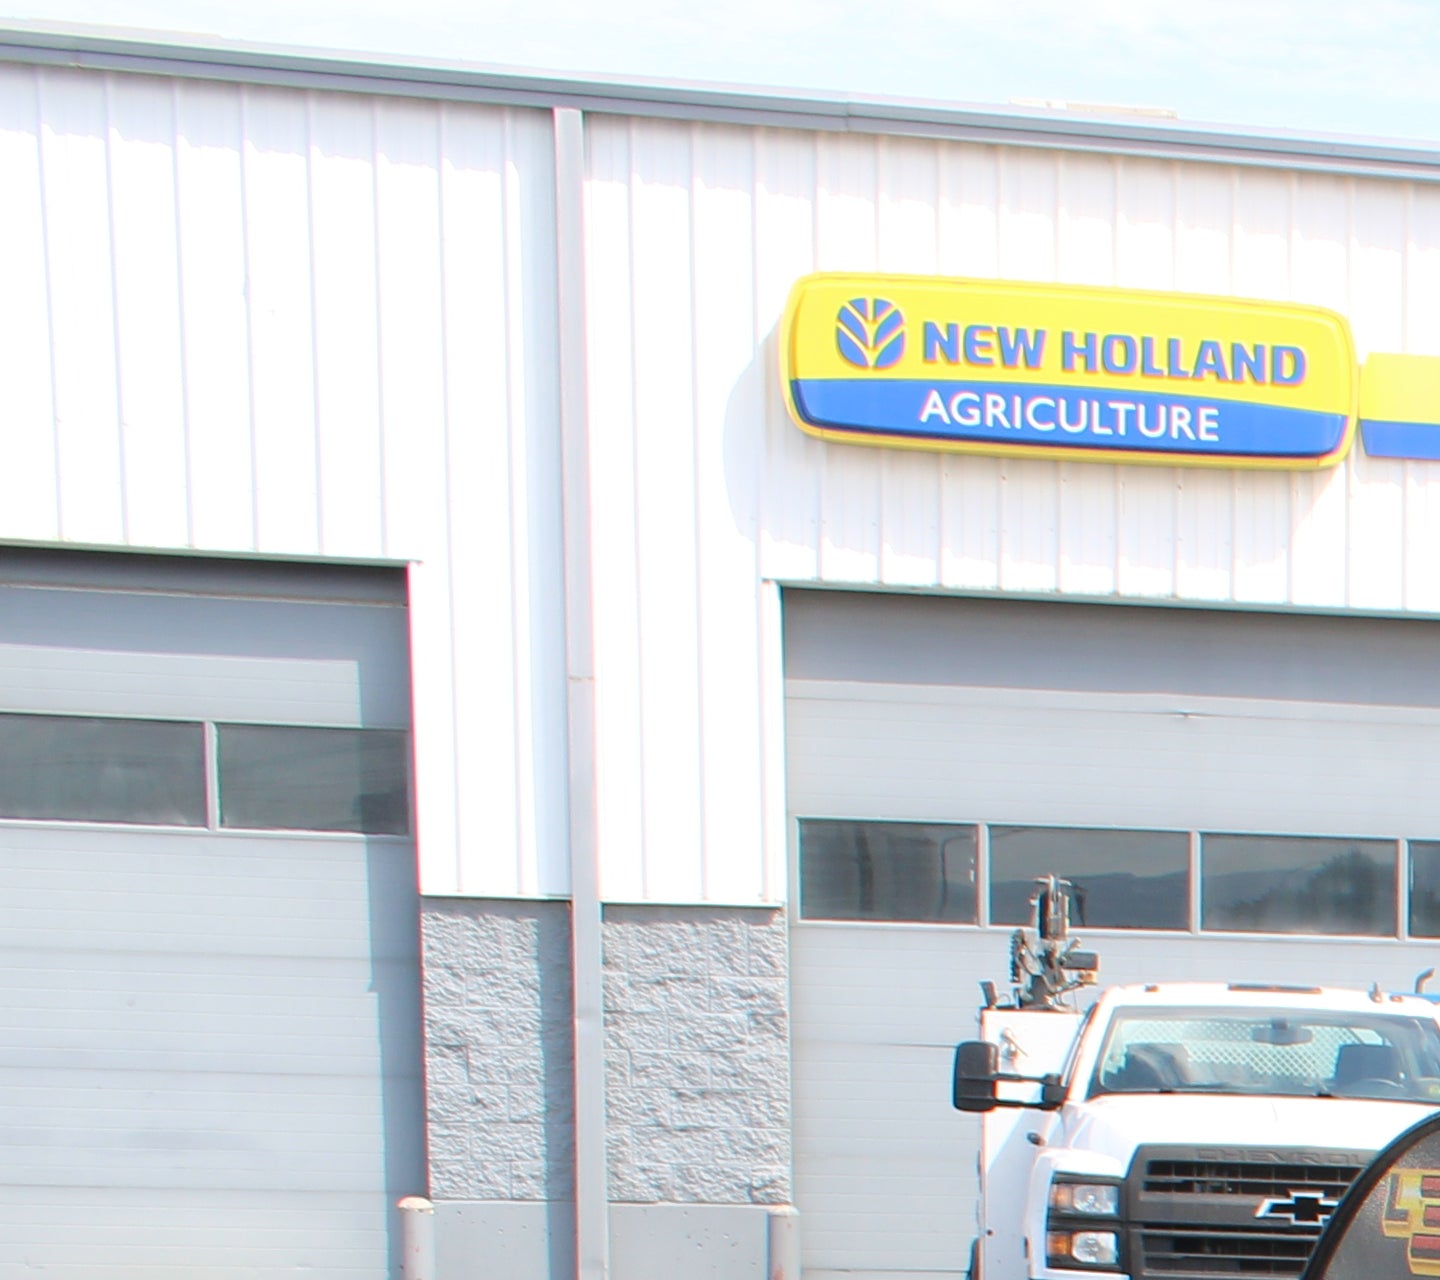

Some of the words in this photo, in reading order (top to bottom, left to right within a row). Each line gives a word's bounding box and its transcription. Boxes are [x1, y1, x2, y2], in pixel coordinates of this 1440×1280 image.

[922, 319, 1047, 371] NEW
[1060, 329, 1307, 387] HOLLAND
[919, 389, 1221, 442] AGRICULTURE
[1197, 1148, 1368, 1166] CHEVROL
